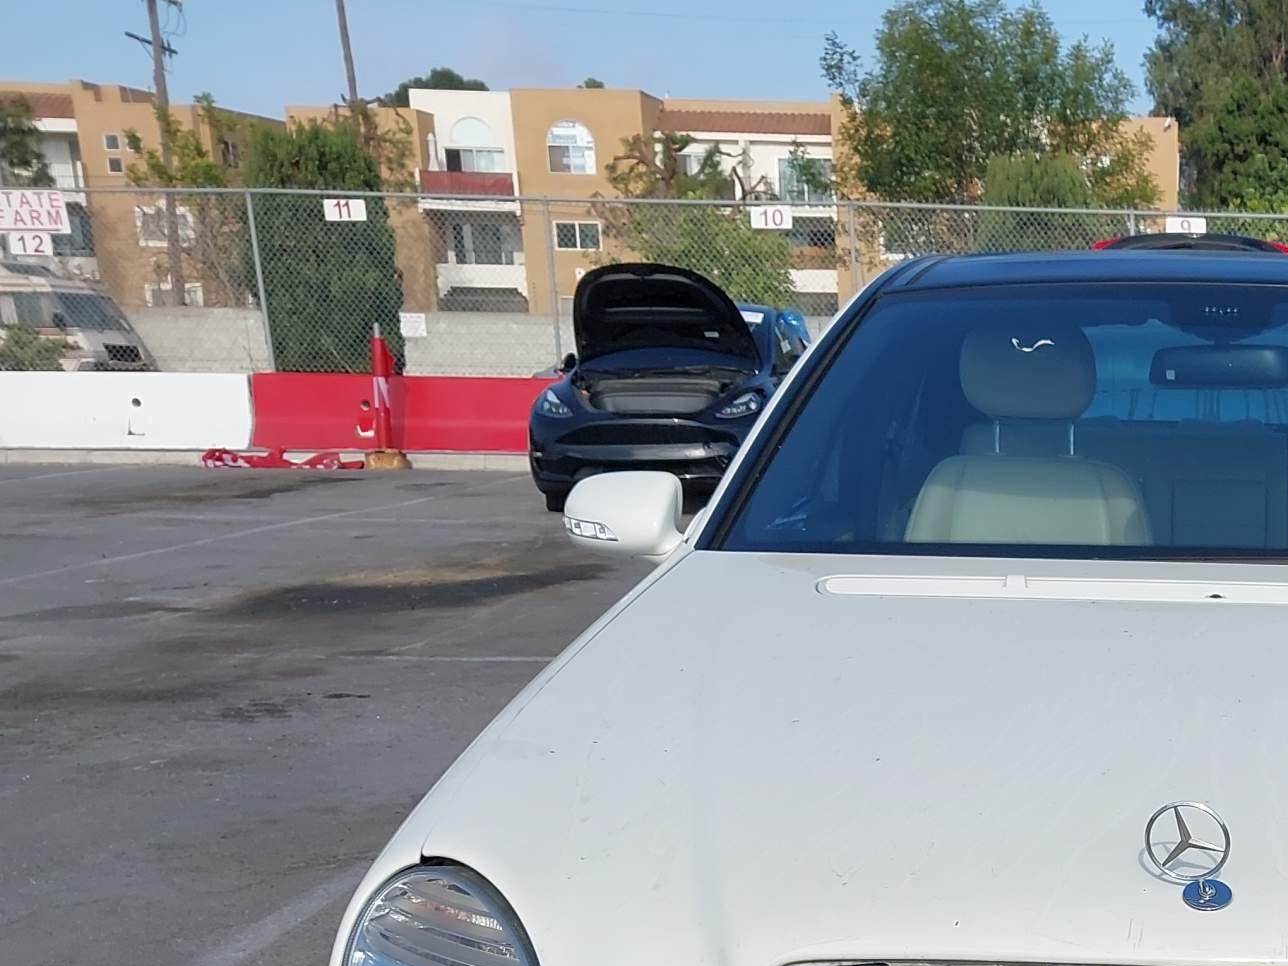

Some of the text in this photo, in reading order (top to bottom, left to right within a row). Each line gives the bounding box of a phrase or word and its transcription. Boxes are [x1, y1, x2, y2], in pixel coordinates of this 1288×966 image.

[0, 191, 62, 209] TATE
[333, 200, 352, 219] 11
[760, 208, 784, 227] 10
[1180, 219, 1192, 233] 9
[17, 234, 46, 253] 12
